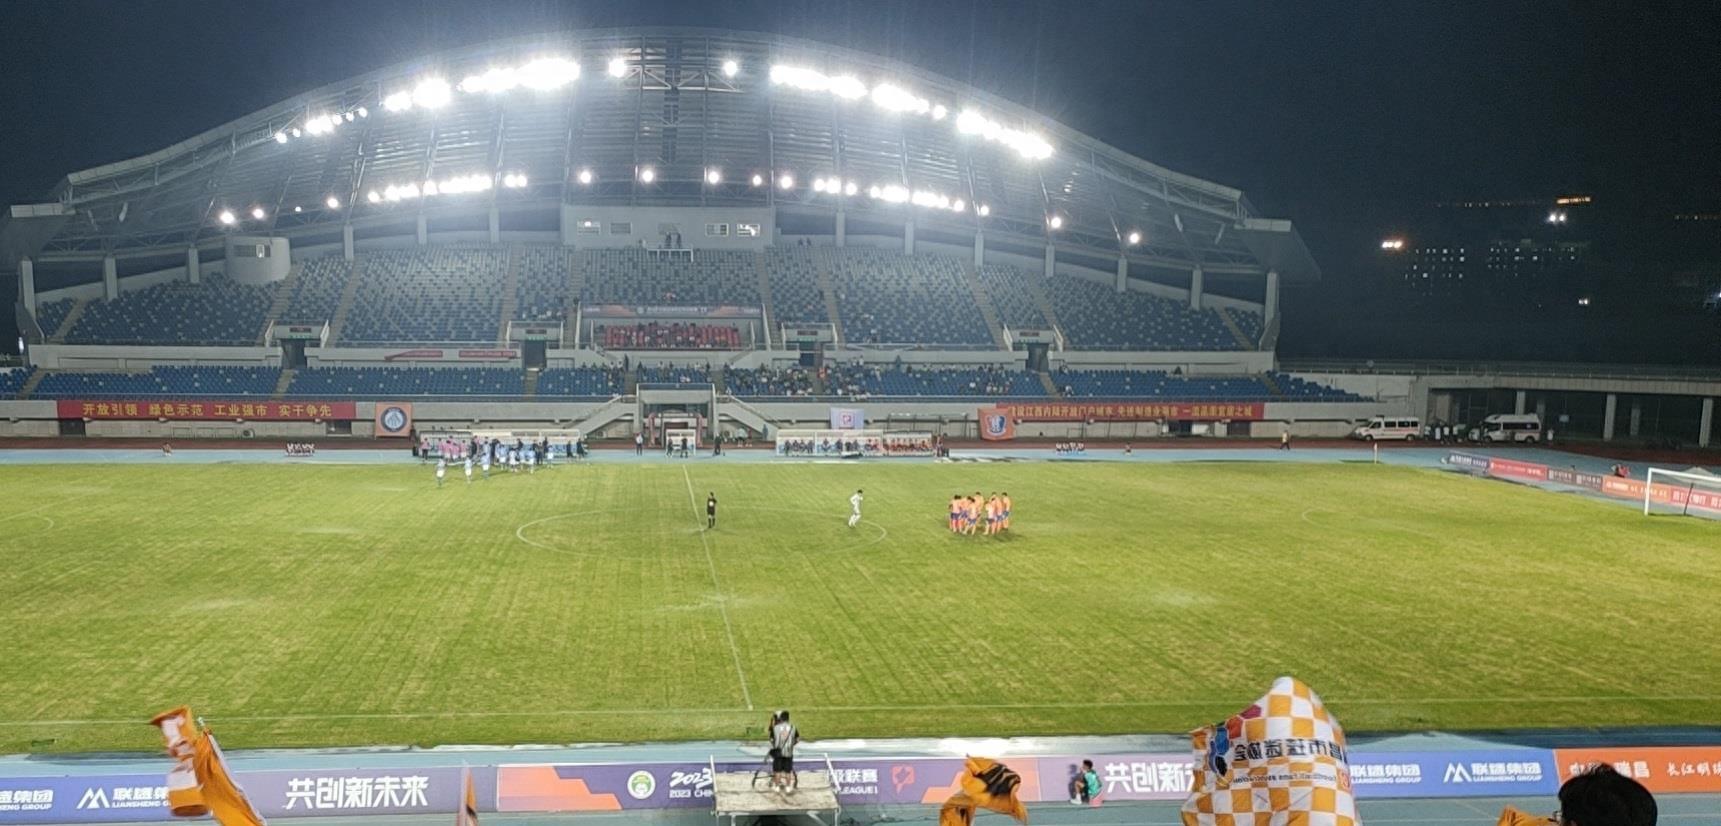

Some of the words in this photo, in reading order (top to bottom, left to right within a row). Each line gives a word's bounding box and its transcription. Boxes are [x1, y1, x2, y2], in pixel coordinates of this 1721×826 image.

[82, 403, 138, 416] 开放引领
[149, 403, 202, 416] 绿色示范
[214, 403, 267, 416] 工业强市
[278, 403, 332, 416] 实干争先
[669, 767, 713, 789] 2023
[285, 775, 430, 810] 共创新未来
[669, 789, 692, 798] 2023
[21, 803, 53, 811] GROUP
